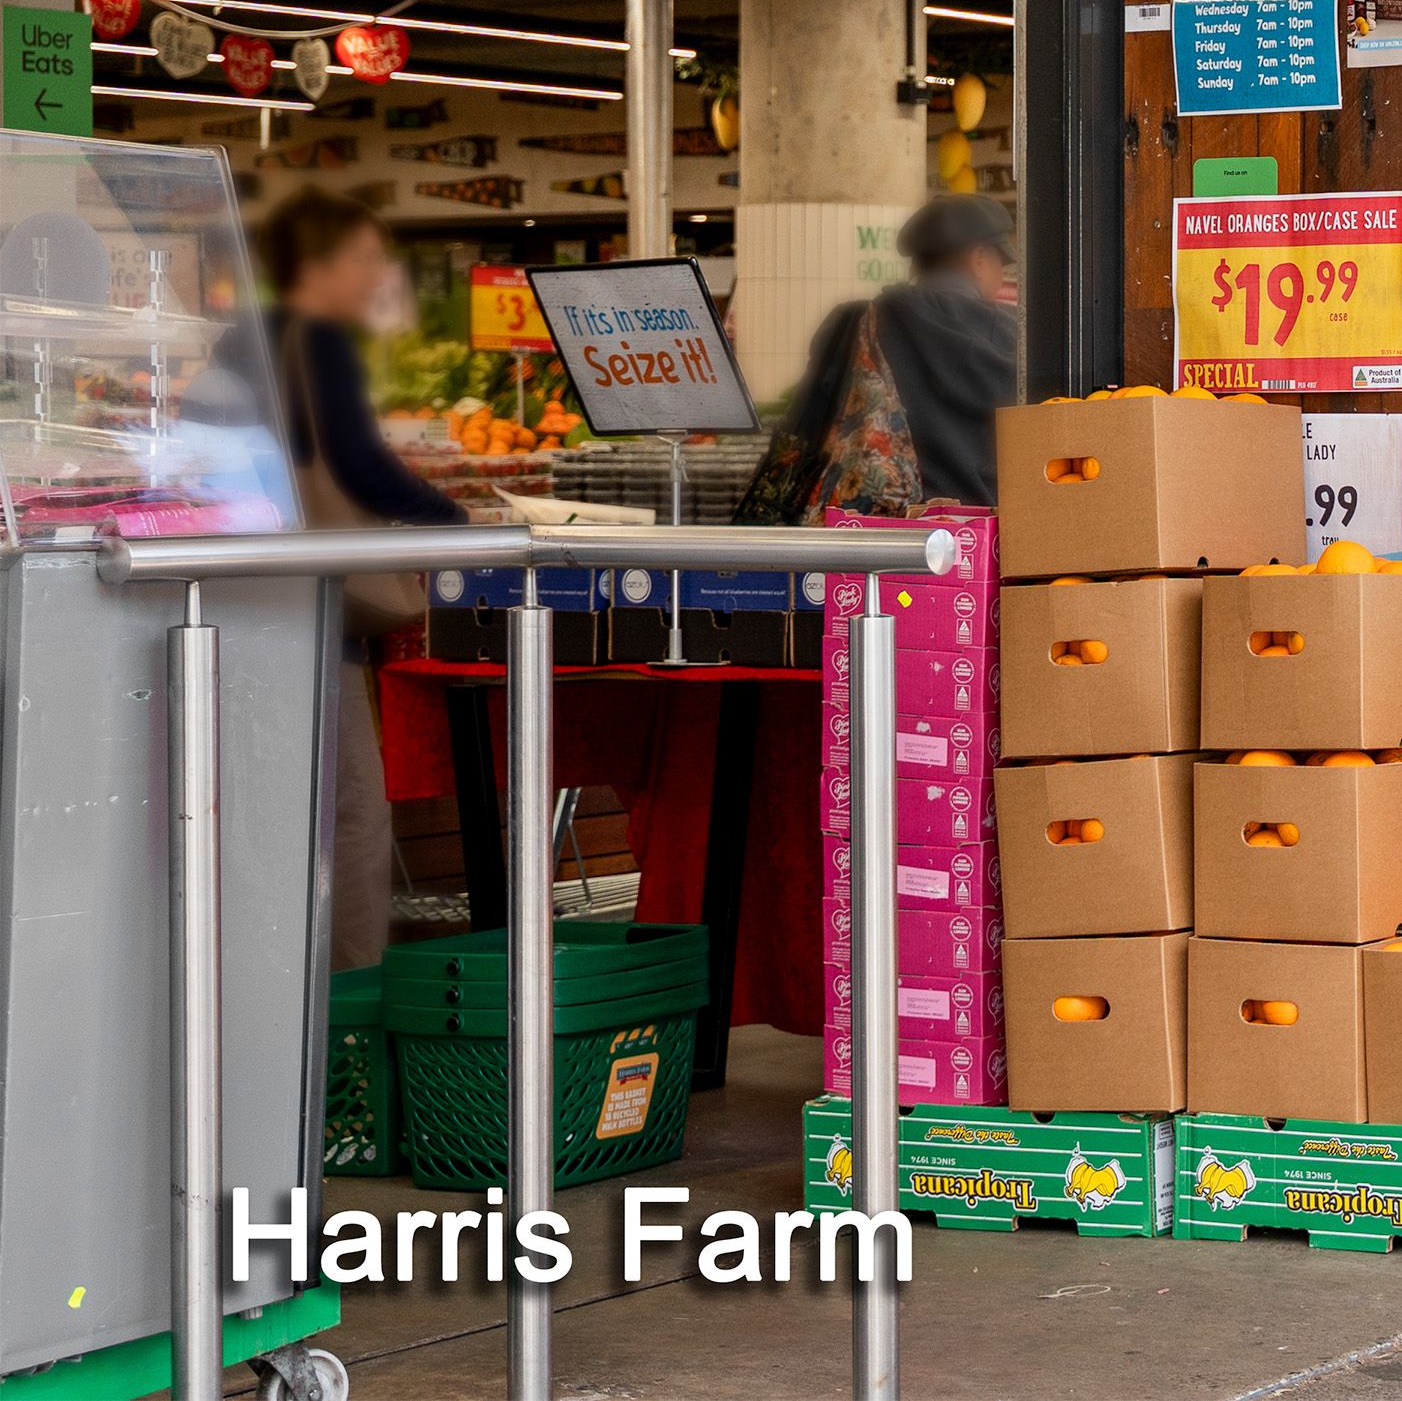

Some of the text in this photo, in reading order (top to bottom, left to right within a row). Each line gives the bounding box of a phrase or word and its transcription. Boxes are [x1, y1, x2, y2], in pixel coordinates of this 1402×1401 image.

[1196, 0, 1313, 16] Wednesday 7am 10pm
[1195, 19, 1313, 35] Thursday 7am 10pm
[22, 24, 74, 49] Uber
[1196, 37, 1313, 53] Friday 7am 10pm
[22, 51, 73, 75] Eats
[1197, 55, 1314, 72] Saturday 7am 10pm
[1198, 74, 1315, 90] Sunday 7am 10pm
[1186, 209, 1397, 234] NAVEL ORANGES BOX/CASE SALE
[1211, 259, 1358, 347] $19.99
[564, 305, 584, 336] If
[611, 307, 635, 333] in
[1330, 312, 1348, 322] case
[584, 338, 718, 388] Seize it!
[1184, 363, 1259, 389] SPECIAL
[1371, 376, 1399, 384] Australia
[1307, 445, 1336, 460] LADY
[1306, 485, 1357, 527] .99
[976, 1129, 989, 1142] the
[1350, 1144, 1367, 1159] the
[931, 1157, 956, 1165] SINCE
[1284, 1170, 1332, 1180] SINCE 1974
[912, 1169, 1038, 1210] Tropicana
